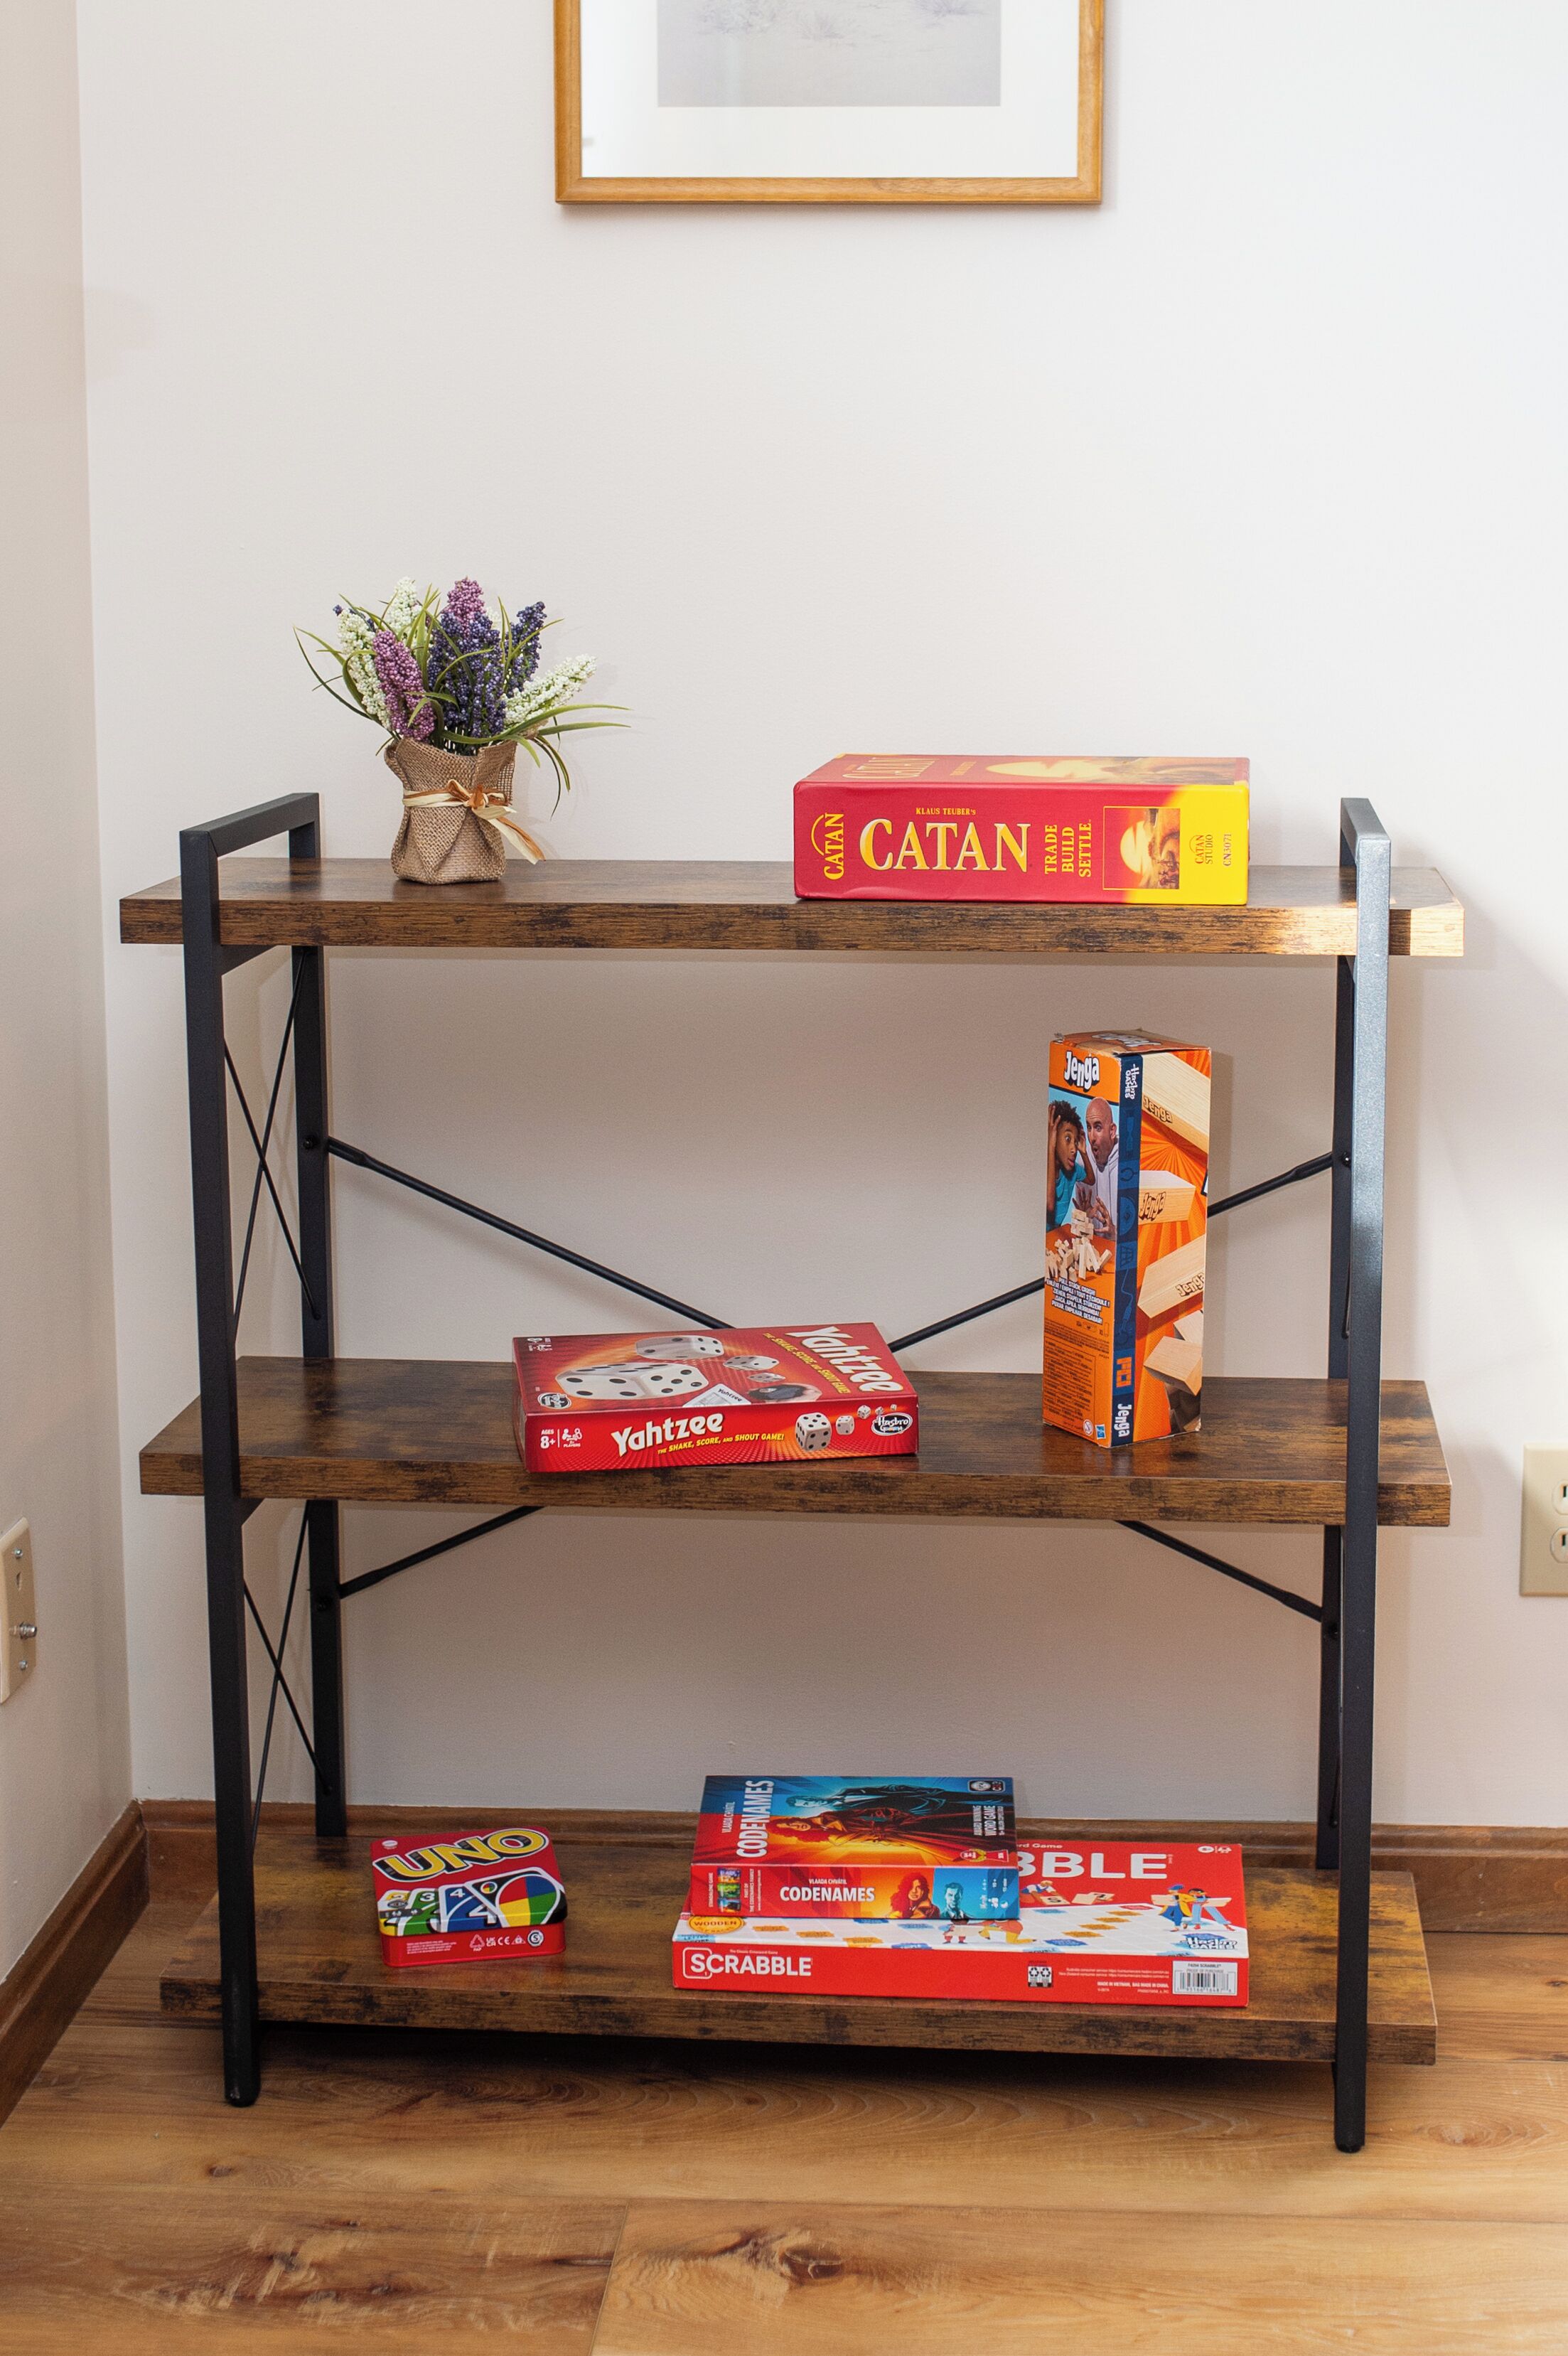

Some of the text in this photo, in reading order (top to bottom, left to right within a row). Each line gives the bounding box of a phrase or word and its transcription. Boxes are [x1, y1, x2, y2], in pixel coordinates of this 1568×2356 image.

[824, 813, 844, 880] CATAN
[859, 818, 1031, 872] CATAN
[1045, 824, 1058, 874] TRADE
[1061, 827, 1074, 873] BUILD
[1195, 834, 1205, 864] CATAN
[1064, 1050, 1100, 1091] Jenga
[1131, 1064, 1139, 1100] Hasbro
[1143, 1094, 1173, 1123] Jenga
[1139, 1192, 1166, 1221] Jenga
[785, 1326, 903, 1392] Yahtzee
[611, 1413, 724, 1457] Yahtzee
[874, 1413, 909, 1428] Hasbro
[1114, 1403, 1132, 1437] Jenga
[540, 1435, 556, 1449] 8+
[668, 1441, 694, 1452] SHAKE,
[696, 1437, 721, 1447] SCORE,
[735, 1433, 759, 1442] SHOUT
[736, 1780, 775, 1858] CODENAMES
[374, 1828, 549, 1882] UNO
[420, 1892, 435, 1902] 3
[450, 1888, 466, 1898] 4
[780, 1886, 875, 1902] CODENAMES
[691, 1954, 812, 1976] SCRABBLE
